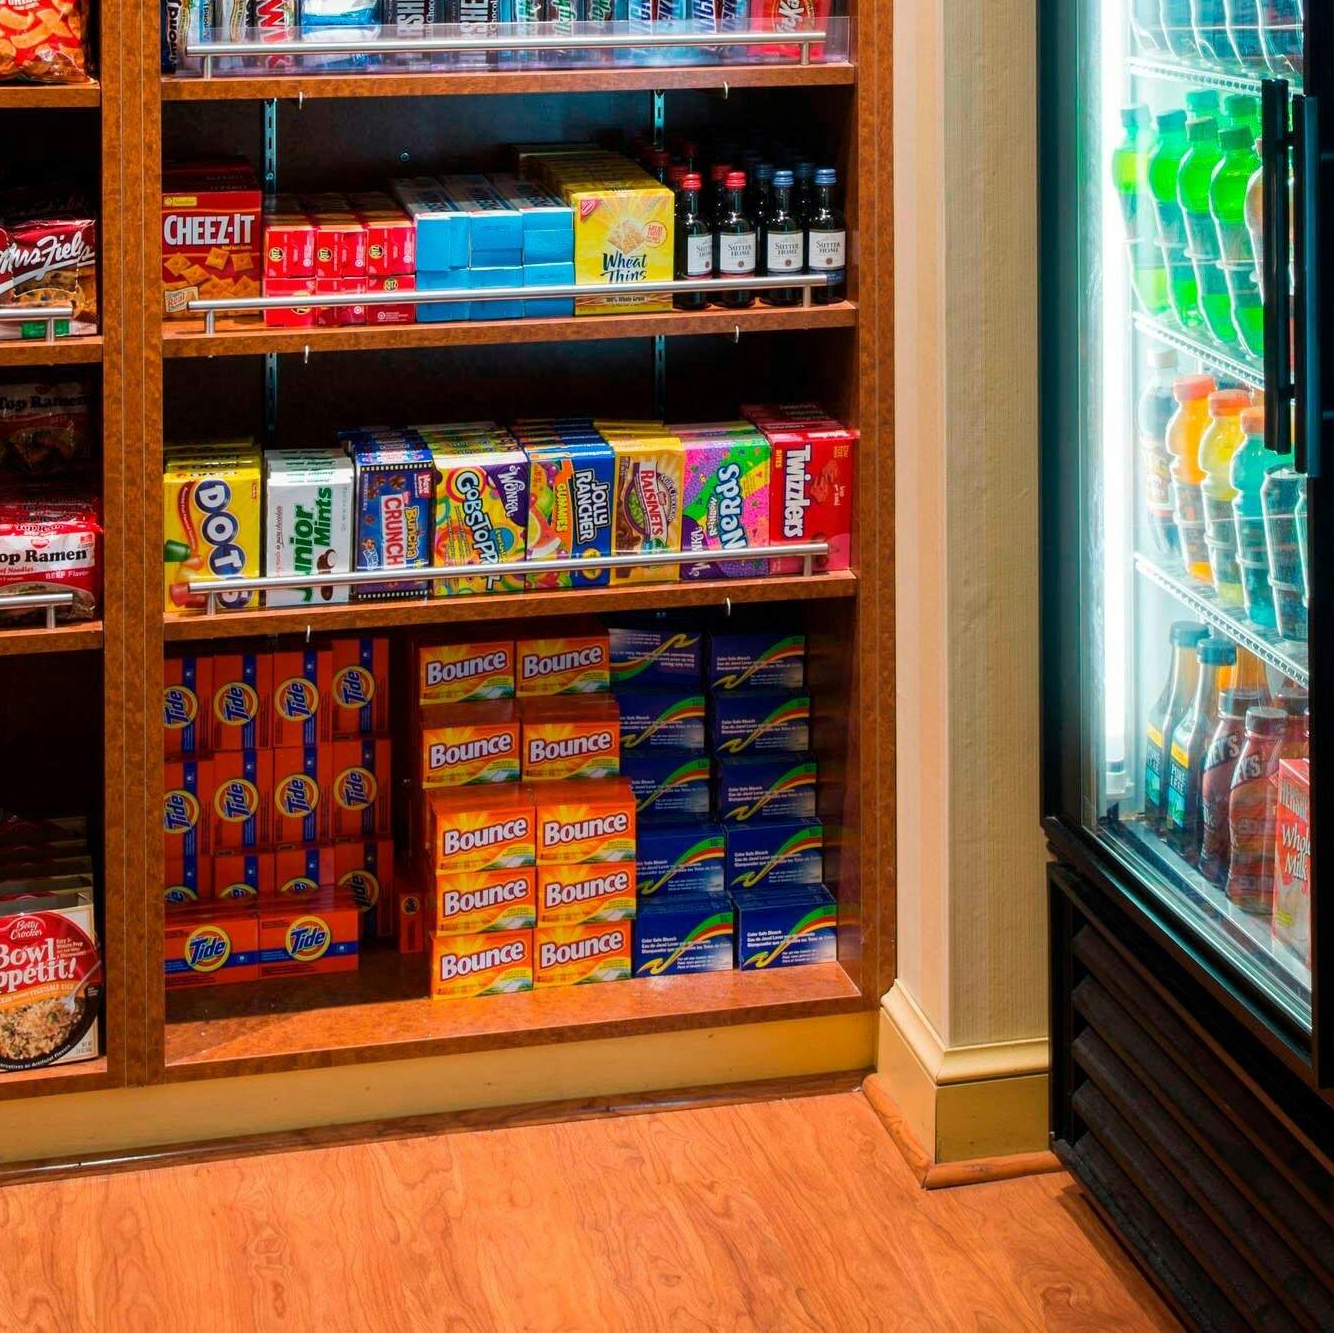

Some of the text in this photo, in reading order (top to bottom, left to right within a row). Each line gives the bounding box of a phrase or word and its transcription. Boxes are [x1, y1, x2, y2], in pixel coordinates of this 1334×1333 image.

[163, 213, 255, 246] CHEEZ-IT
[602, 252, 648, 271] Wheat
[315, 487, 332, 547] Mints
[554, 482, 568, 533] GUMMIES
[575, 470, 595, 544] RANCHER
[591, 480, 611, 528] JOLLY
[640, 469, 664, 537] RAISINETS
[384, 496, 404, 567] CRUNCH
[24, 549, 87, 563] Ramen
[426, 651, 506, 686] Bounce
[523, 645, 604, 679] Bounce
[226, 683, 249, 723] Tide
[286, 680, 310, 719] Tide
[344, 669, 366, 706] Tide
[430, 732, 512, 768] Bounce
[529, 729, 612, 764] Bounce
[226, 781, 249, 819] Tide
[286, 775, 310, 815] Tide
[344, 770, 366, 808] Tide
[165, 792, 186, 832] Tide
[543, 813, 628, 846] Bounce
[443, 818, 528, 855] Bounce
[1282, 822, 1310, 853] Whol
[1285, 851, 1308, 881] Milk
[443, 880, 528, 916] Bounce
[545, 872, 629, 908] Bounce
[189, 936, 227, 964] Tide
[289, 925, 328, 954] Tide
[540, 930, 623, 968] Bounce
[440, 941, 525, 981] Bounce
